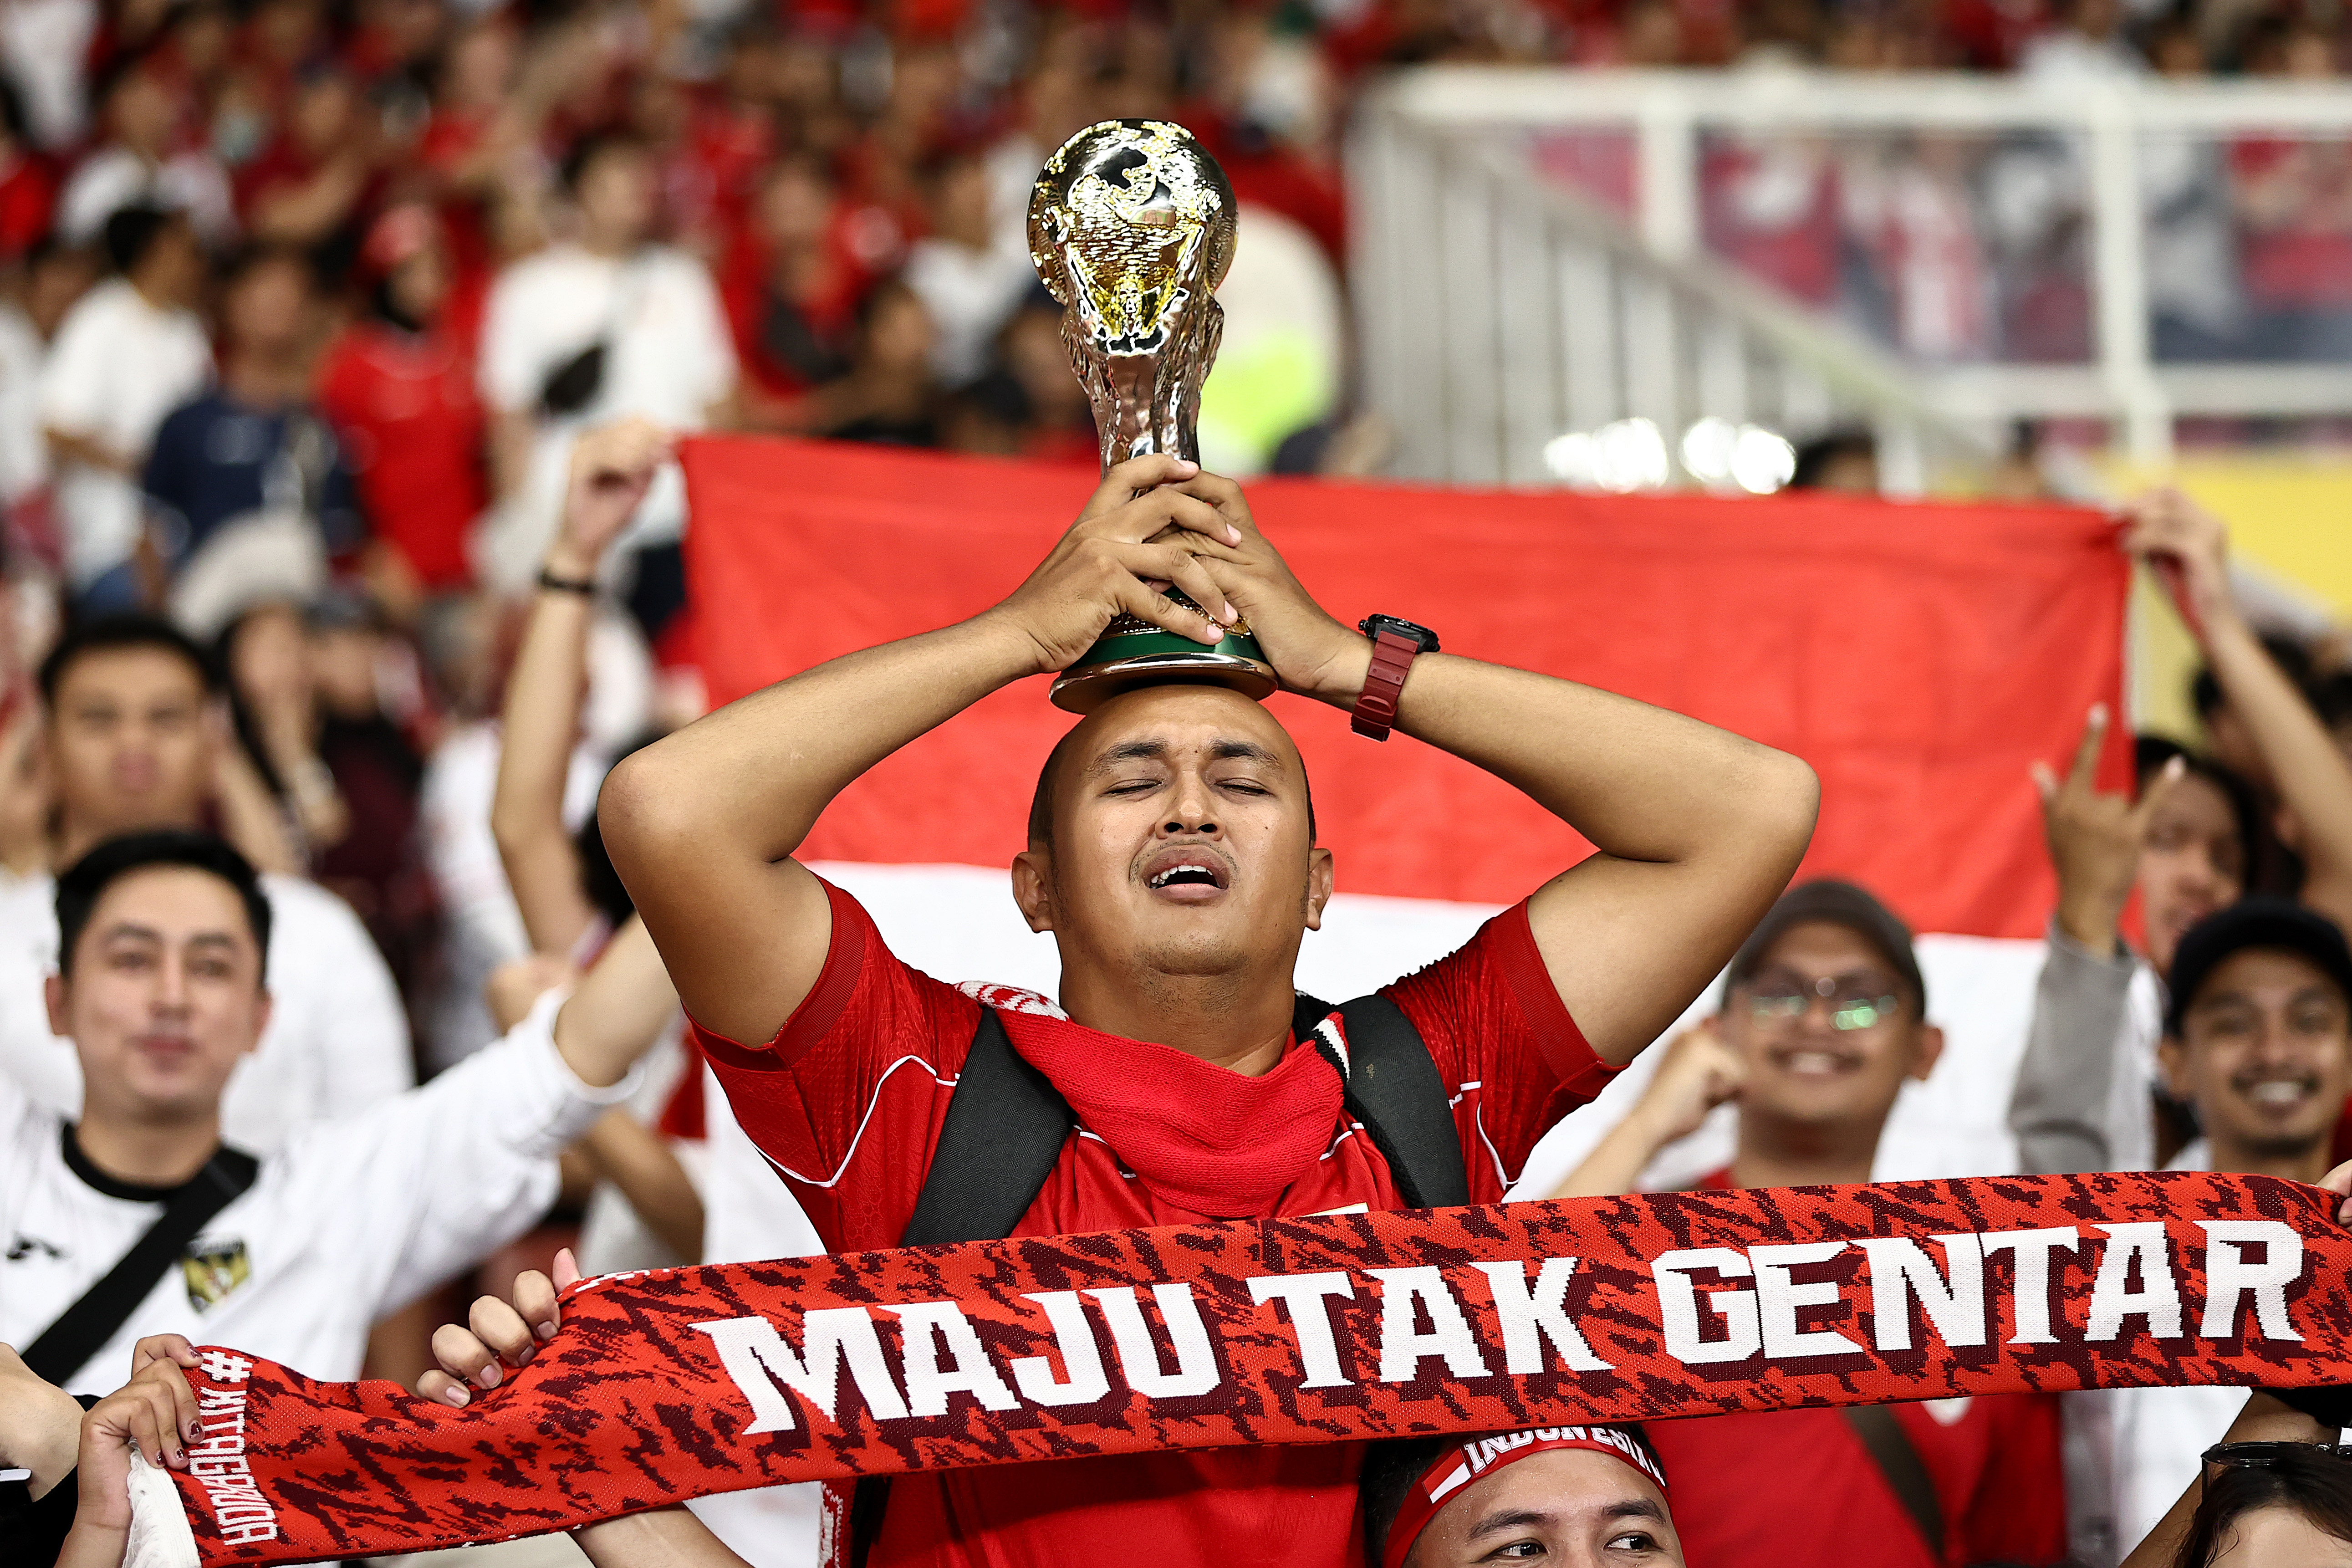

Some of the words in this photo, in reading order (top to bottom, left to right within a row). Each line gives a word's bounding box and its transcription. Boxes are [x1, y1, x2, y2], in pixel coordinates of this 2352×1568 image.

[687, 1282, 1221, 1435] MAJU
[1245, 1255, 1616, 1391] TAK
[1650, 1218, 2306, 1366] GENTAR
